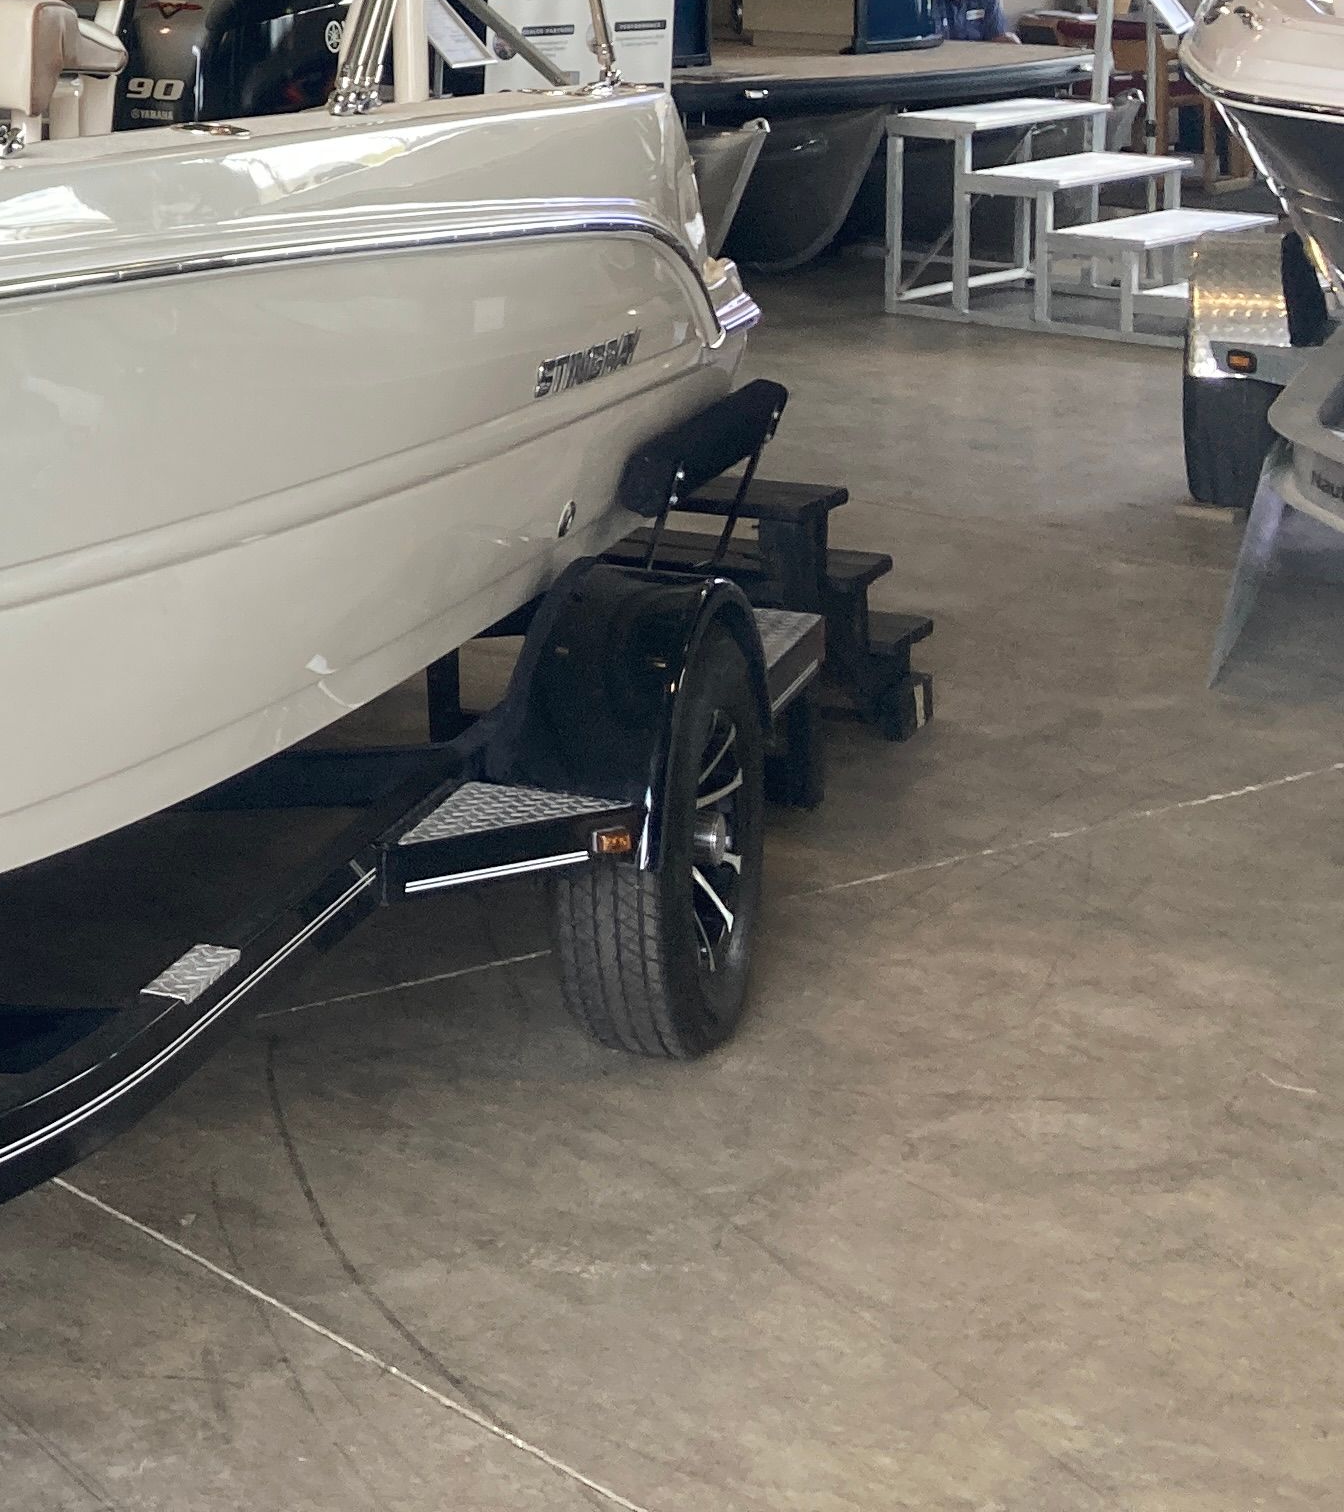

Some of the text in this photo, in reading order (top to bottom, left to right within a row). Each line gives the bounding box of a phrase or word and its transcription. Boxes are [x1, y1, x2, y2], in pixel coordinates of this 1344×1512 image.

[126, 77, 185, 100] 90
[141, 109, 173, 120] YAMAHA
[535, 329, 641, 397] STINGRAY
